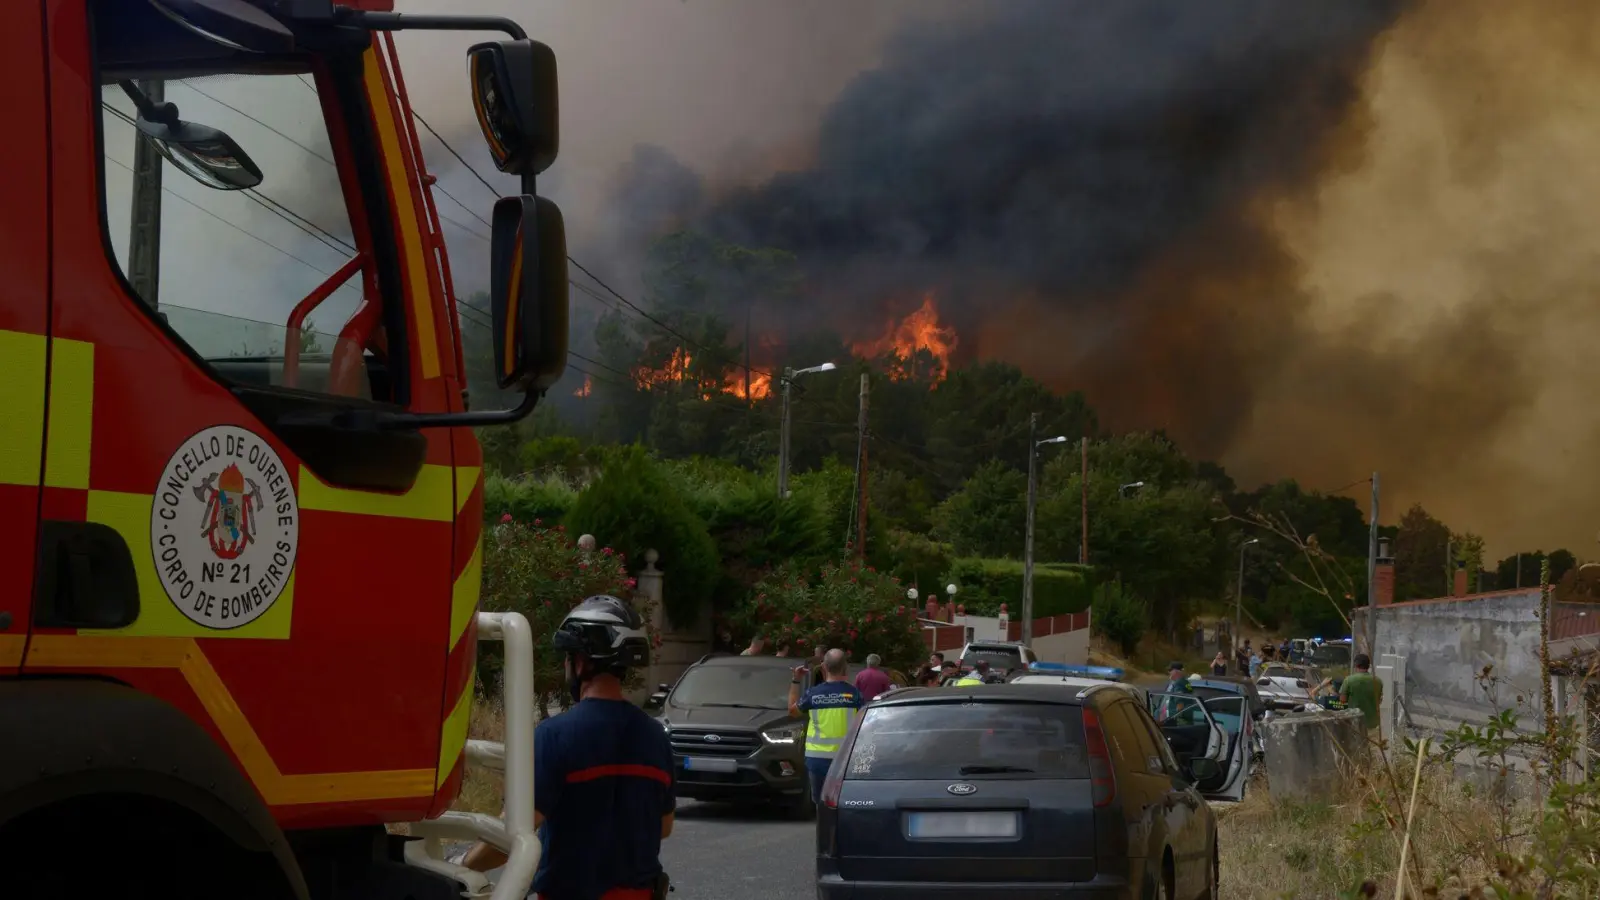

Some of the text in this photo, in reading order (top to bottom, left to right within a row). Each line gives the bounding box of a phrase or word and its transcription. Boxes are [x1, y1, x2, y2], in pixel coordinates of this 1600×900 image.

[160, 435, 292, 527] CONCELLO DE OURENSE
[159, 534, 291, 620] CORPO DE BOMBEIROS
[230, 563, 250, 584] 21
